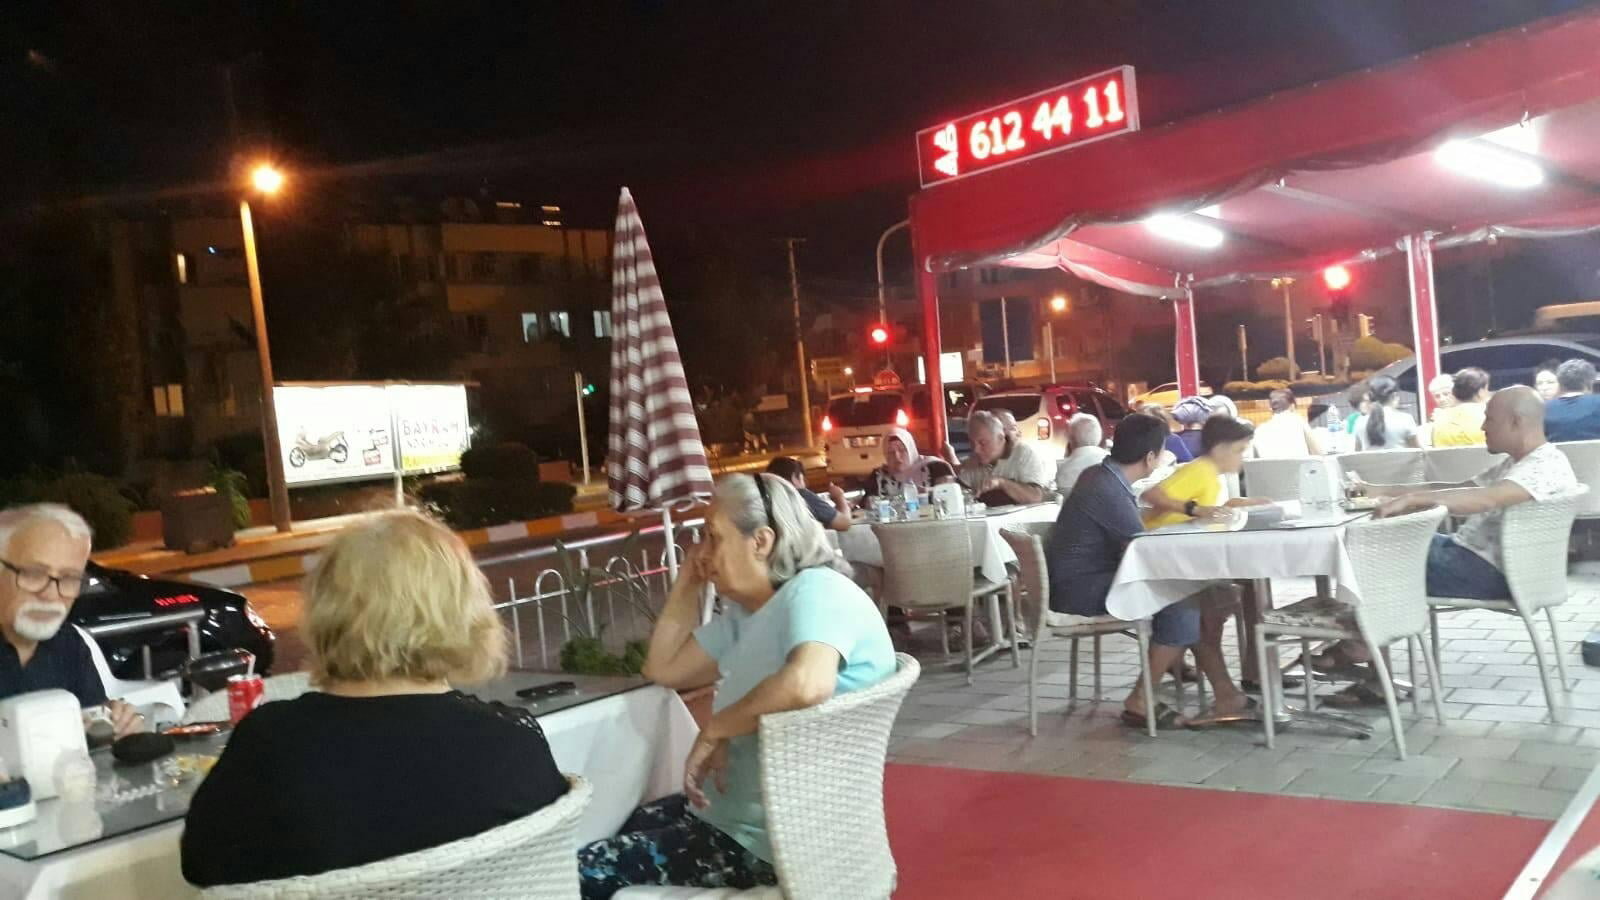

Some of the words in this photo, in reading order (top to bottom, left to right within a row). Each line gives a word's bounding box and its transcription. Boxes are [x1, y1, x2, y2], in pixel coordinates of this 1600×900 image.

[969, 111, 1026, 160] 612
[1031, 95, 1073, 141] 44
[1083, 79, 1125, 129] 11
